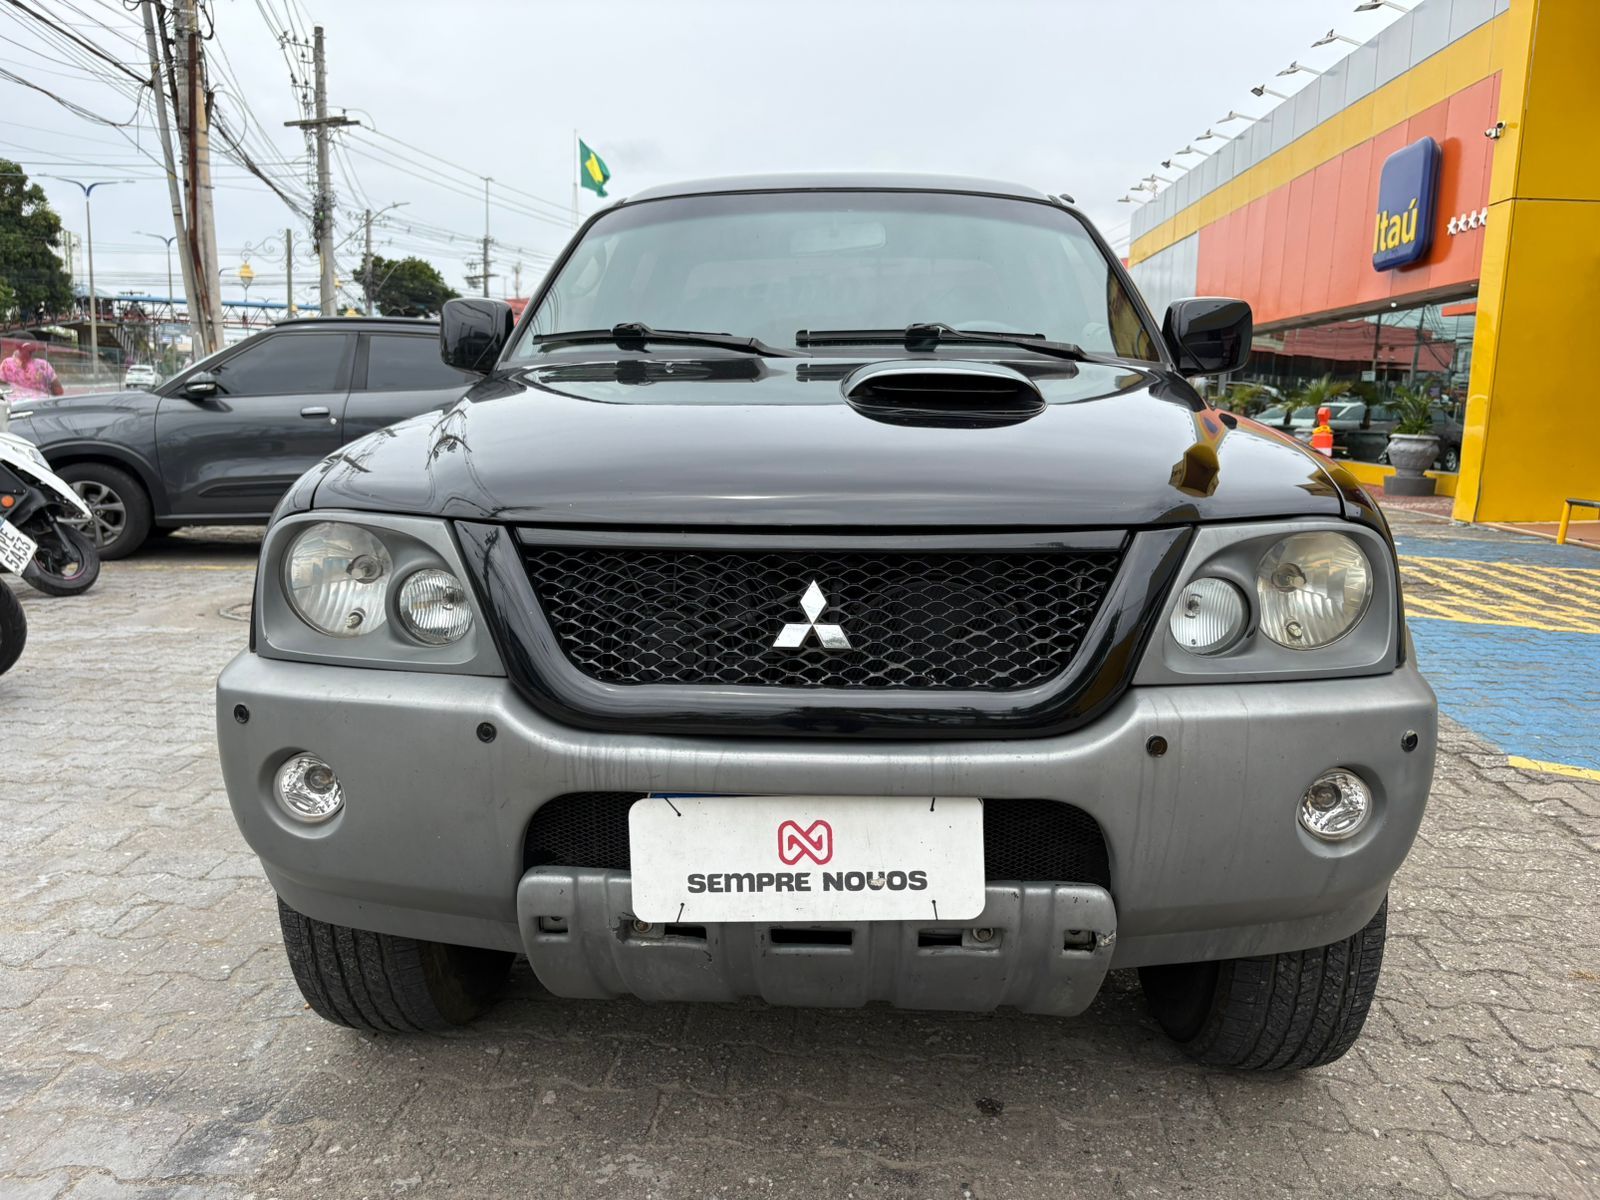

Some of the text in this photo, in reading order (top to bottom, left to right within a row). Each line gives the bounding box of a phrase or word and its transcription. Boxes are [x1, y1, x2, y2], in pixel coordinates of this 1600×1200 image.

[1373, 199, 1418, 254] Itaú
[5, 536, 31, 569] 5A53
[687, 872, 811, 893] SEMPRE
